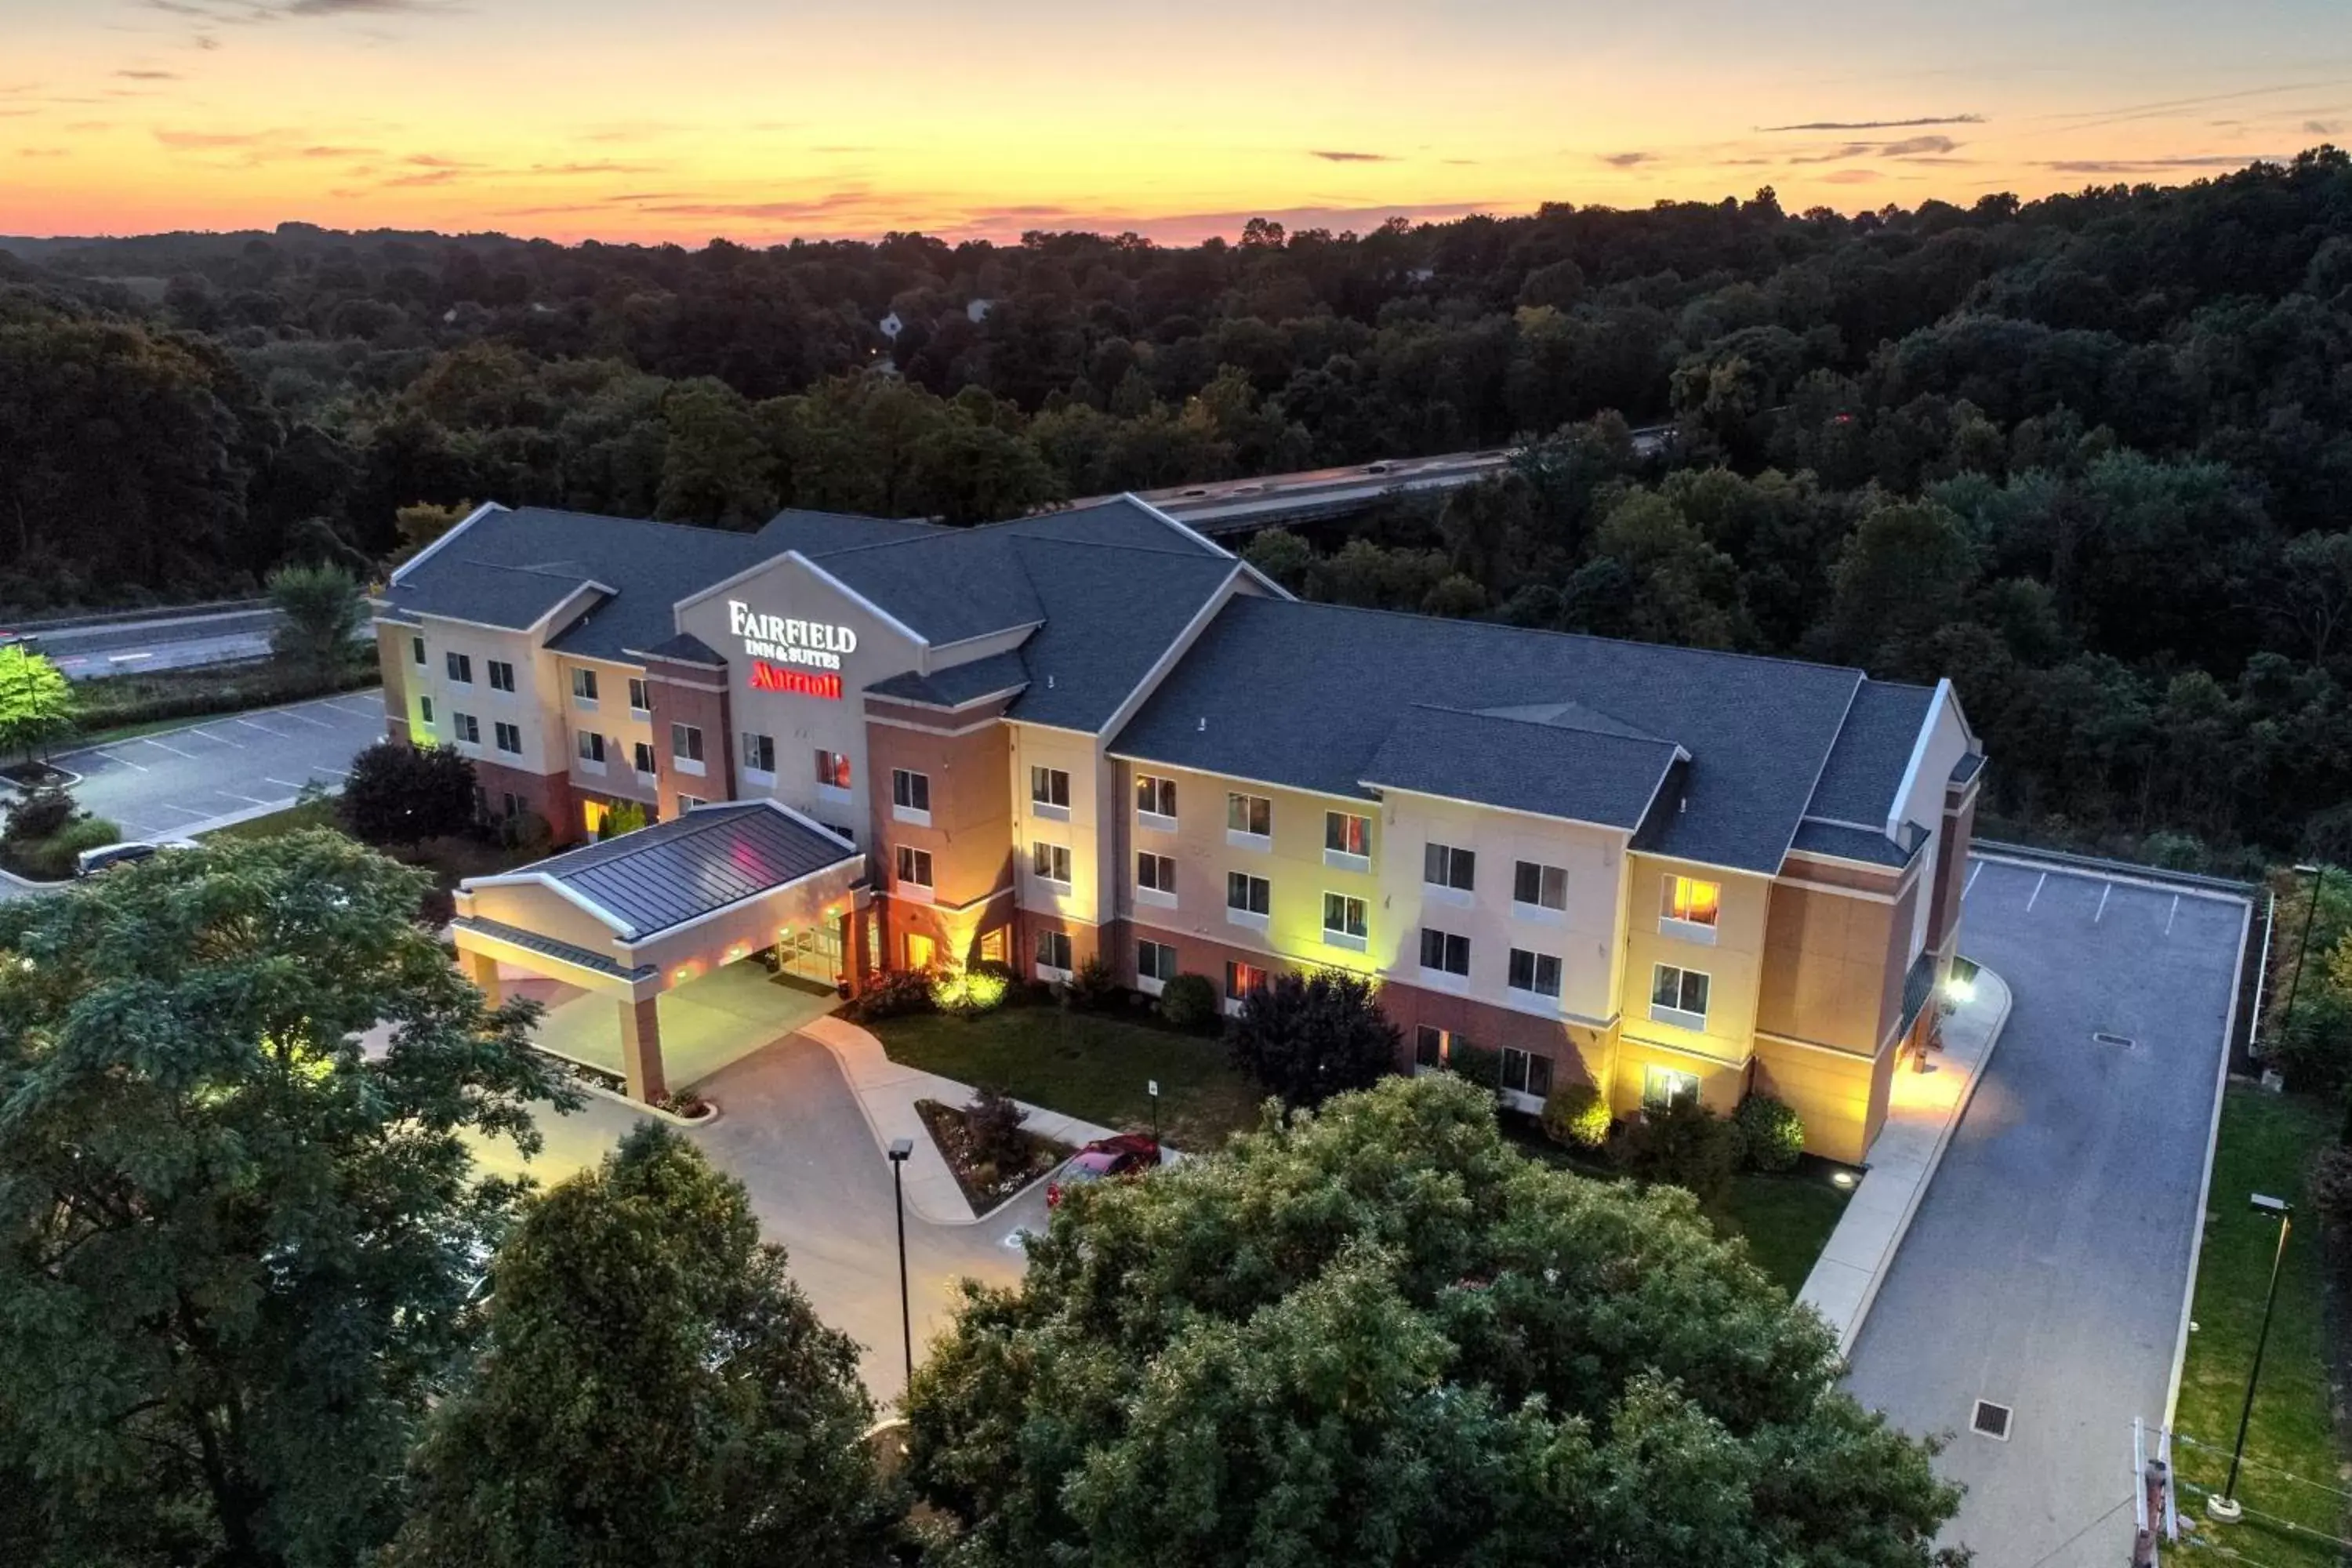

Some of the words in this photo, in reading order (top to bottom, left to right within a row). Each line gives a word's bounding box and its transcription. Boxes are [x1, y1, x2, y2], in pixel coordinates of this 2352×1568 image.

[728, 600, 857, 652] FAIRFIELD
[746, 639, 775, 659] INN
[776, 645, 788, 662] &
[789, 647, 840, 670] SUITES
[750, 660, 842, 699] Marriott
